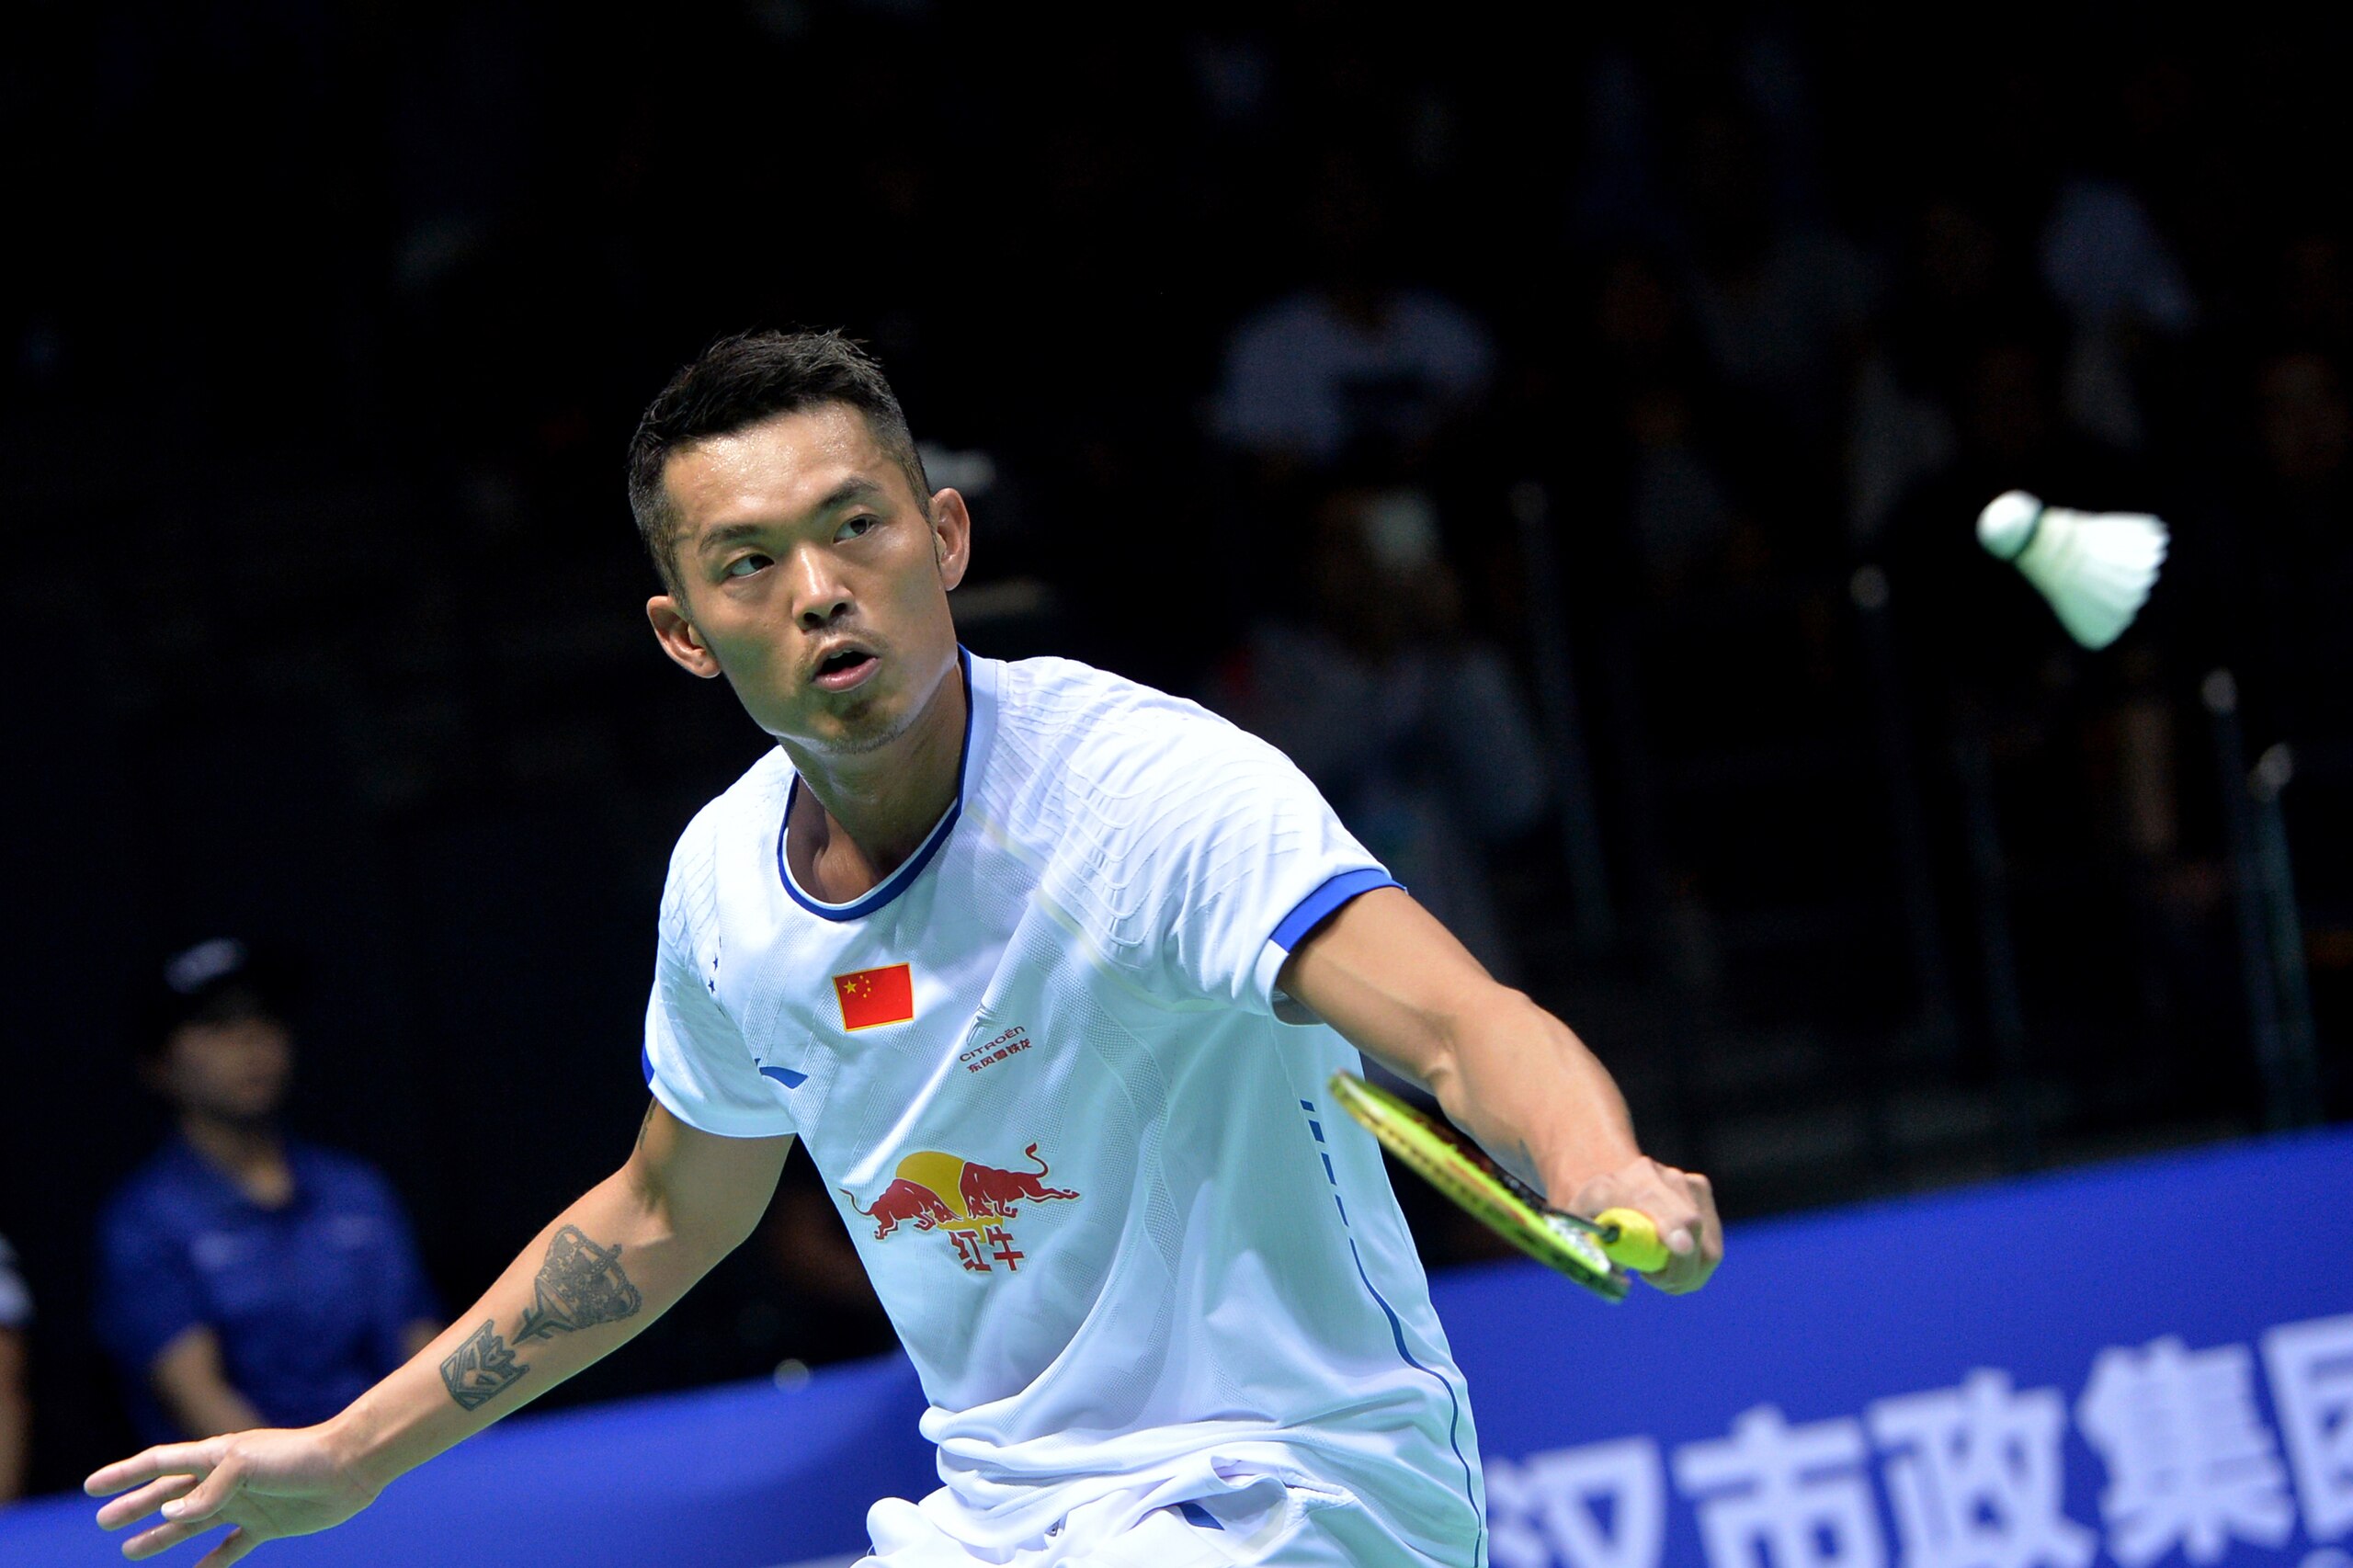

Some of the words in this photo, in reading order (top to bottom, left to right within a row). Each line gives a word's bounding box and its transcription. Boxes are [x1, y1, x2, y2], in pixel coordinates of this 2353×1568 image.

[967, 1038, 1032, 1073] 东风雪铁龙
[948, 1225, 1025, 1271] 红牛
